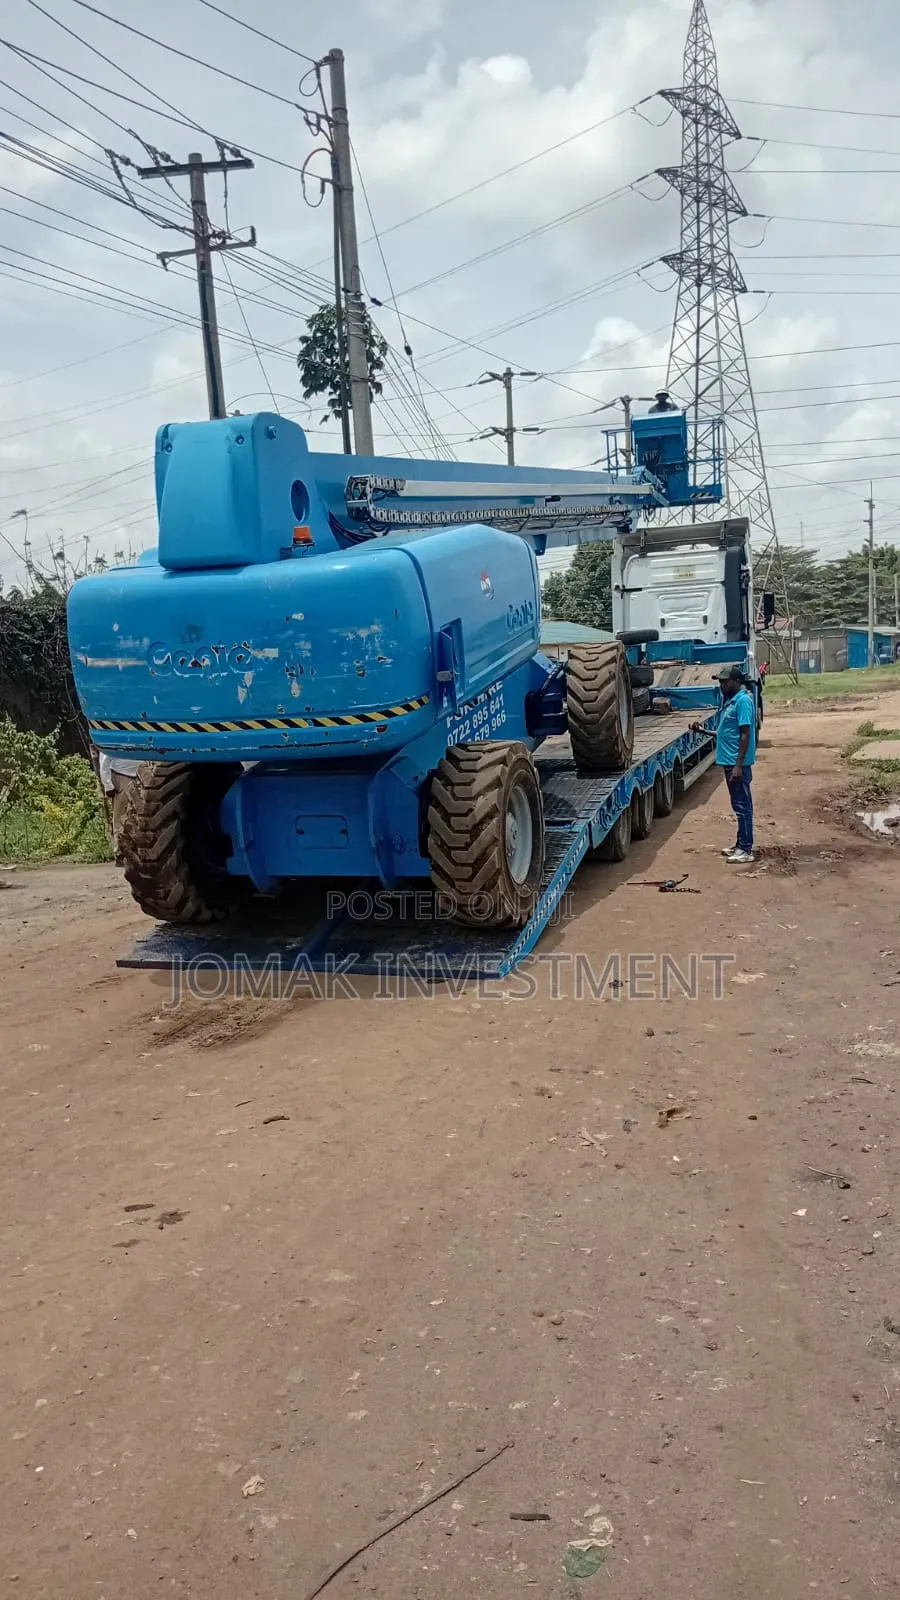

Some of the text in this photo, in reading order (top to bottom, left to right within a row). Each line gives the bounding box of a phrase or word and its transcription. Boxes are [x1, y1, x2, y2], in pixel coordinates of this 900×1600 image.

[447, 692, 504, 747] 0722 895 641
[491, 709, 507, 731] 966
